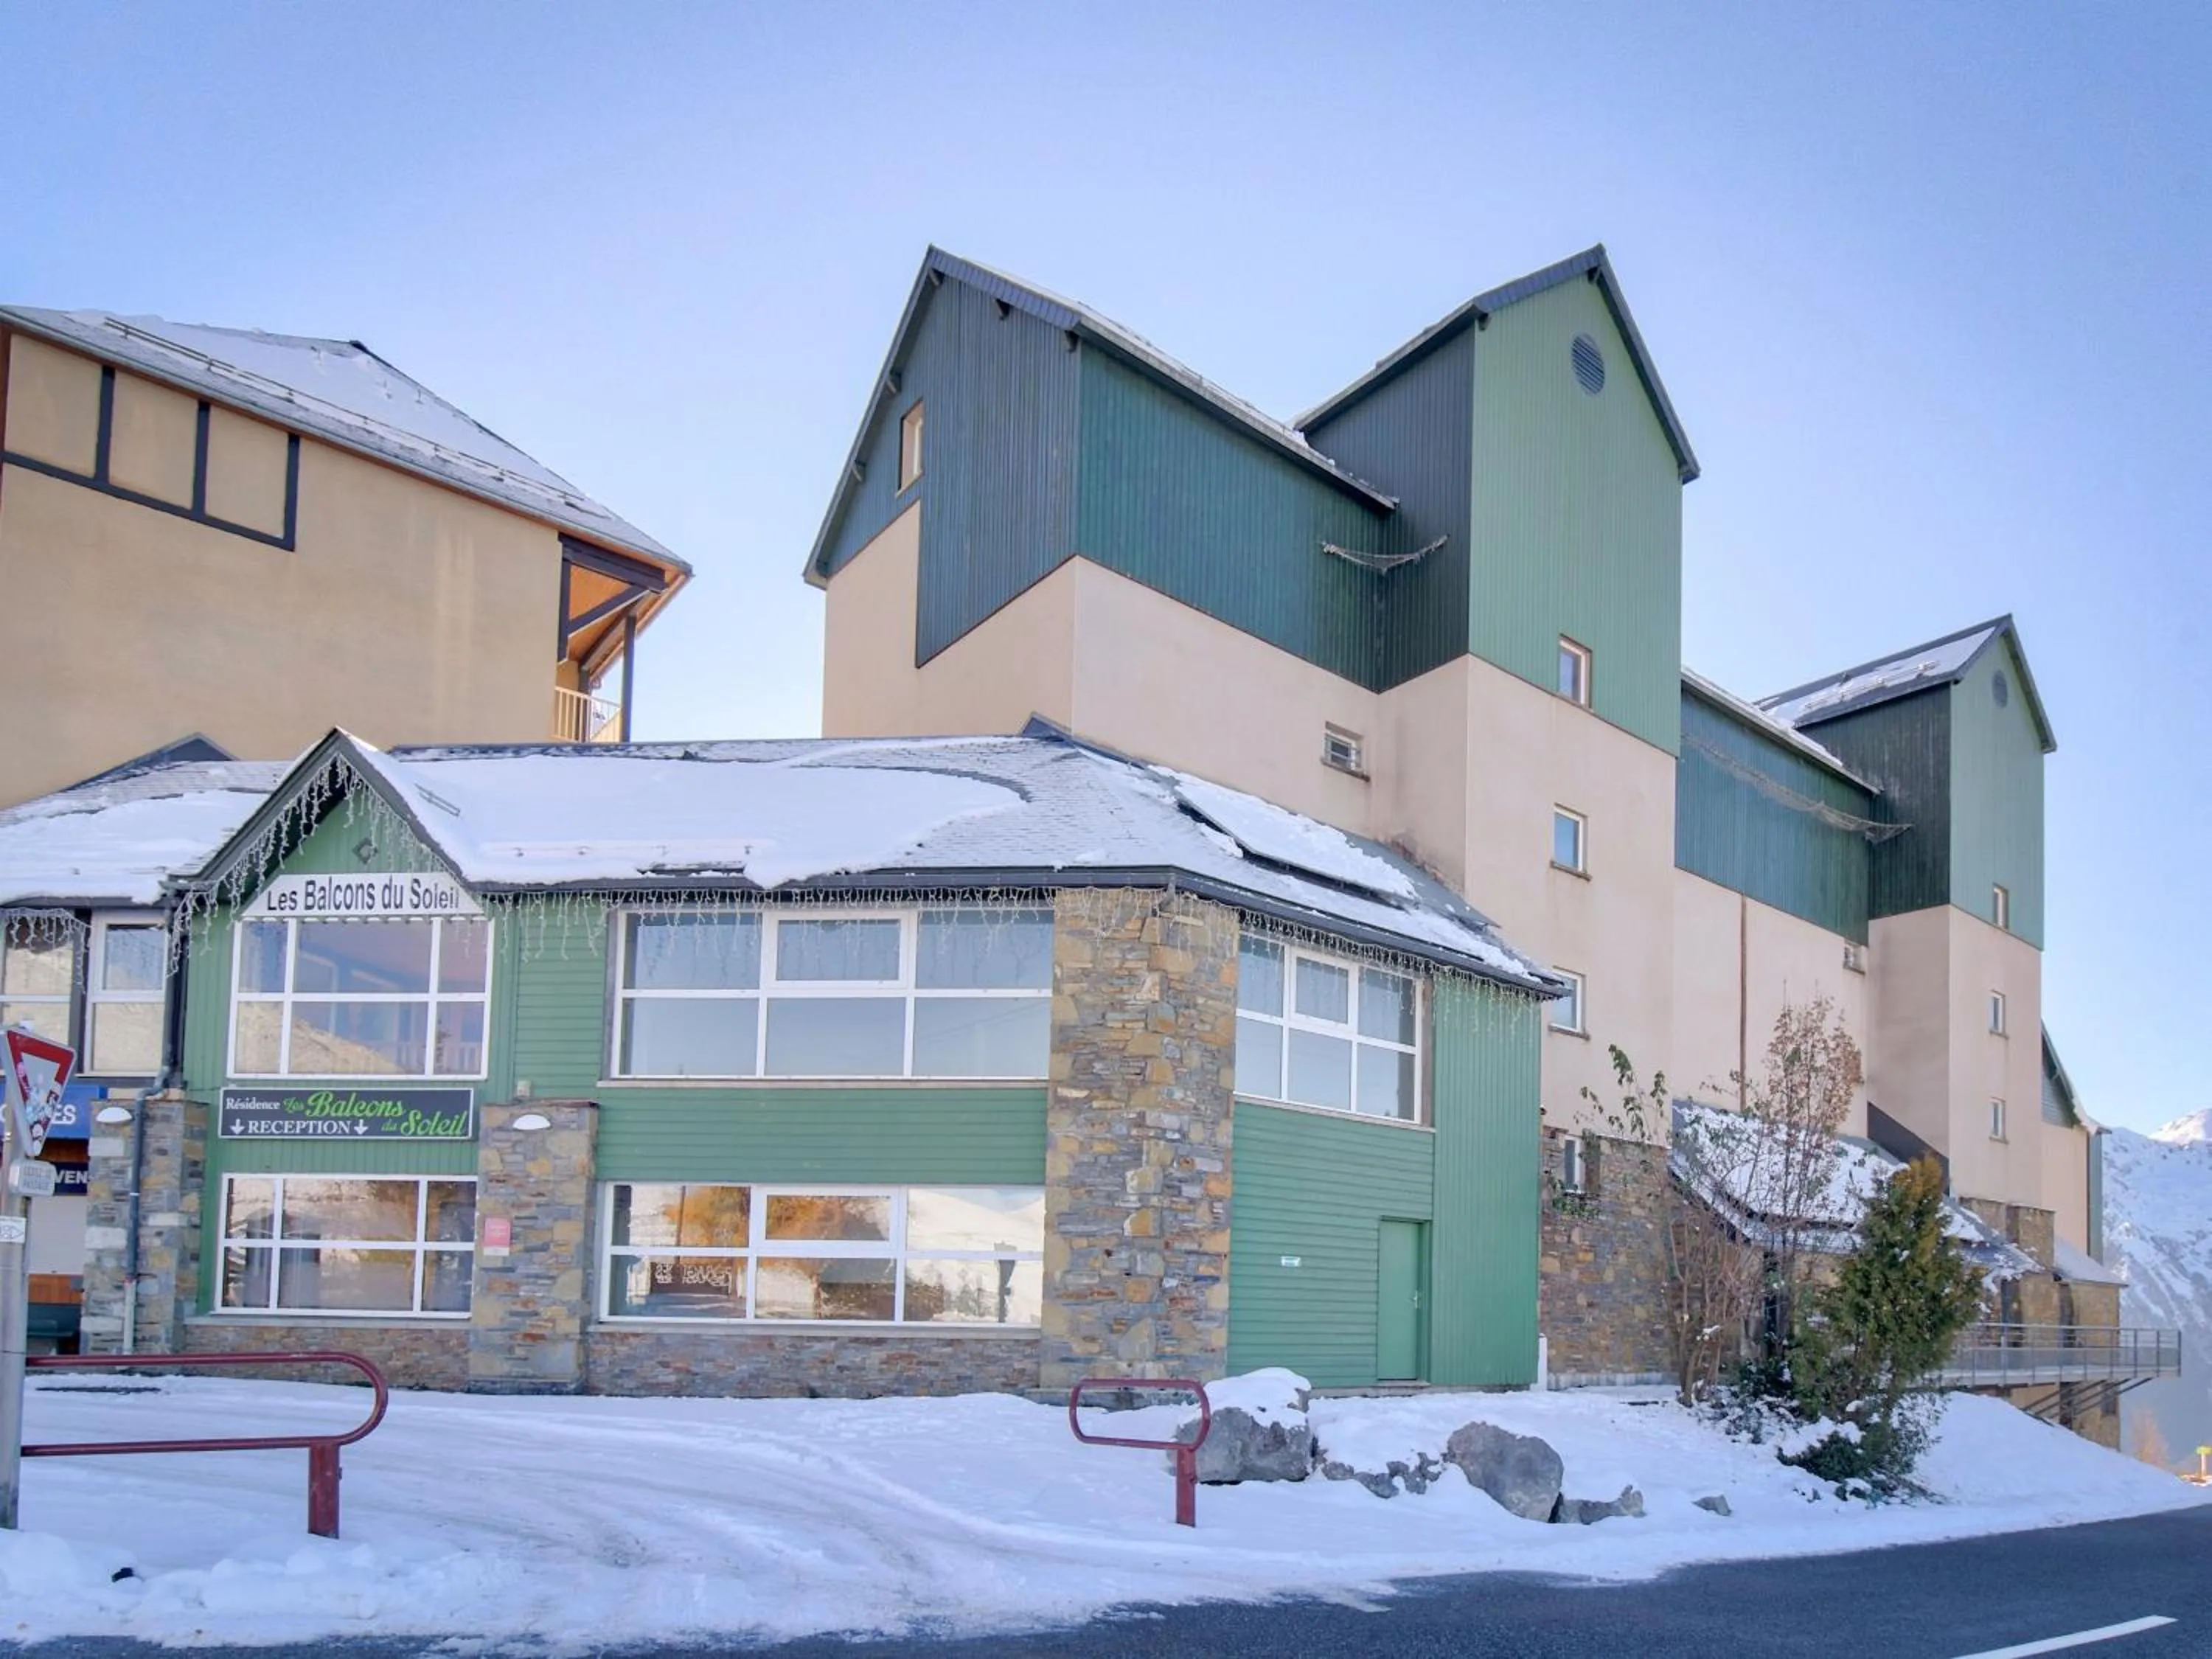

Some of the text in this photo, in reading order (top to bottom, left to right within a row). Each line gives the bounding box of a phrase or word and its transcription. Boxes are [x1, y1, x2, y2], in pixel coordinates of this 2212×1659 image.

[267, 876, 459, 911] Les Balcons du Soleil
[225, 1096, 280, 1110] Résidence
[305, 1091, 405, 1117] Balcons
[247, 1120, 352, 1134] RECEPTION
[400, 1110, 467, 1136] Soleil
